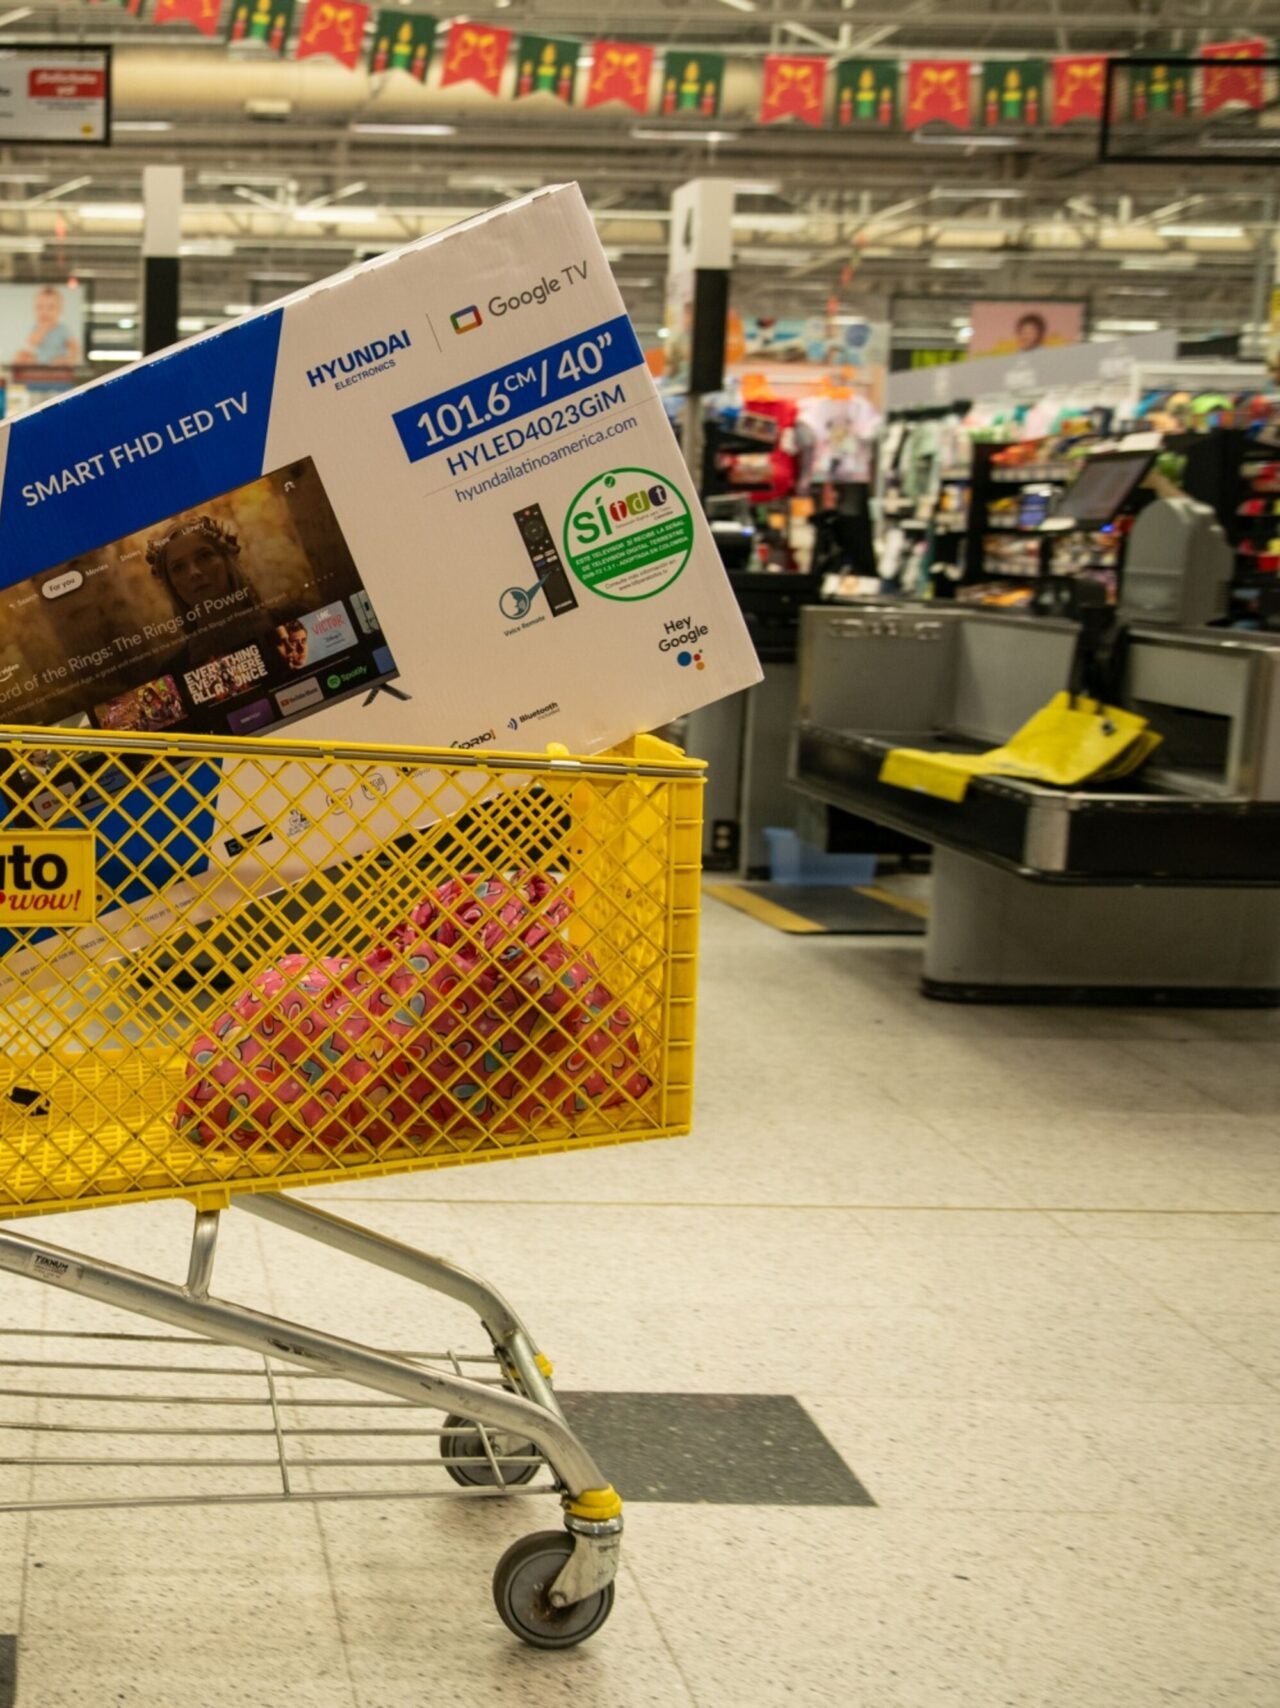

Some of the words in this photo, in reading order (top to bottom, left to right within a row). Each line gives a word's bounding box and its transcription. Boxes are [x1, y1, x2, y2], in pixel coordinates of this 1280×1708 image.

[487, 277, 561, 317] Google
[561, 260, 589, 287] TV
[306, 329, 411, 388] HYUNDAI
[334, 359, 396, 391] ELECTRONICS
[445, 384, 627, 476] HYLED4023GiM
[21, 454, 105, 507] SMART
[109, 431, 164, 470] FHD
[166, 410, 214, 445] LED
[215, 391, 248, 422] TV
[455, 415, 638, 503] hyundailatinoamerica.com
[572, 496, 613, 544] SÍ
[610, 485, 666, 521] tdt
[575, 554, 591, 564] ESTE
[591, 542, 625, 558] TELEVISOR
[633, 530, 656, 543] RECIBE
[655, 526, 664, 534] LA
[625, 541, 649, 554] DIGITAL
[649, 528, 684, 545] TERRESTRE
[658, 535, 688, 550] COLOMBIA
[48, 582, 61, 592] For
[62, 579, 76, 590] you
[85, 563, 109, 577] Movies
[24, 676, 41, 692] of
[42, 667, 68, 684] the
[68, 646, 113, 672] Rings:
[113, 633, 142, 652] The
[143, 614, 184, 641] Rings
[186, 604, 203, 622] of
[204, 586, 249, 615] Power
[658, 624, 708, 652] Google
[664, 616, 692, 635] Hey
[2, 663, 20, 675] video
[340, 665, 368, 681] Spotify
[519, 702, 558, 723] Bluetooth
[8, 889, 81, 912] wow!
